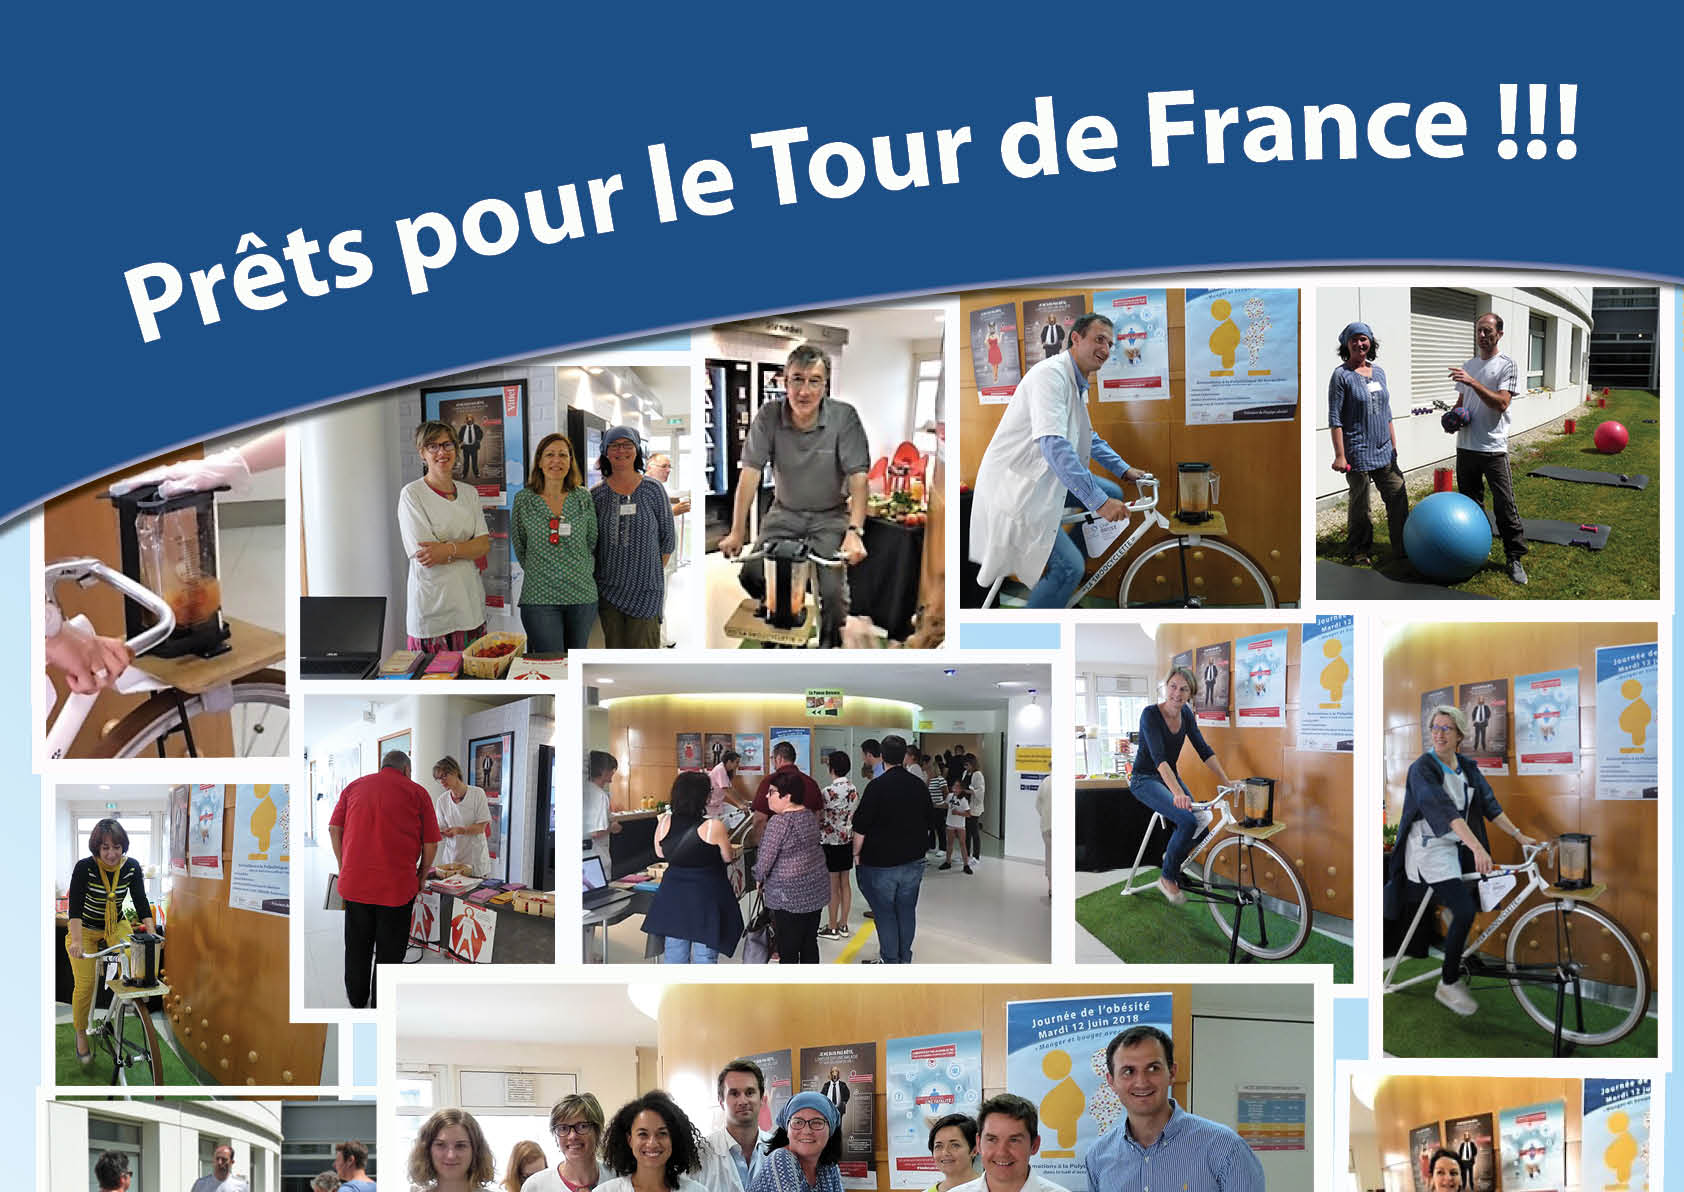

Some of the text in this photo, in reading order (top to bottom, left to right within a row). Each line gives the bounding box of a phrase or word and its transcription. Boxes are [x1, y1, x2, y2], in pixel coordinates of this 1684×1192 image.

[1032, 1001, 1151, 1028] Journée de l'obésité
[1038, 1014, 1139, 1039] Mardi 12 juin 2018
